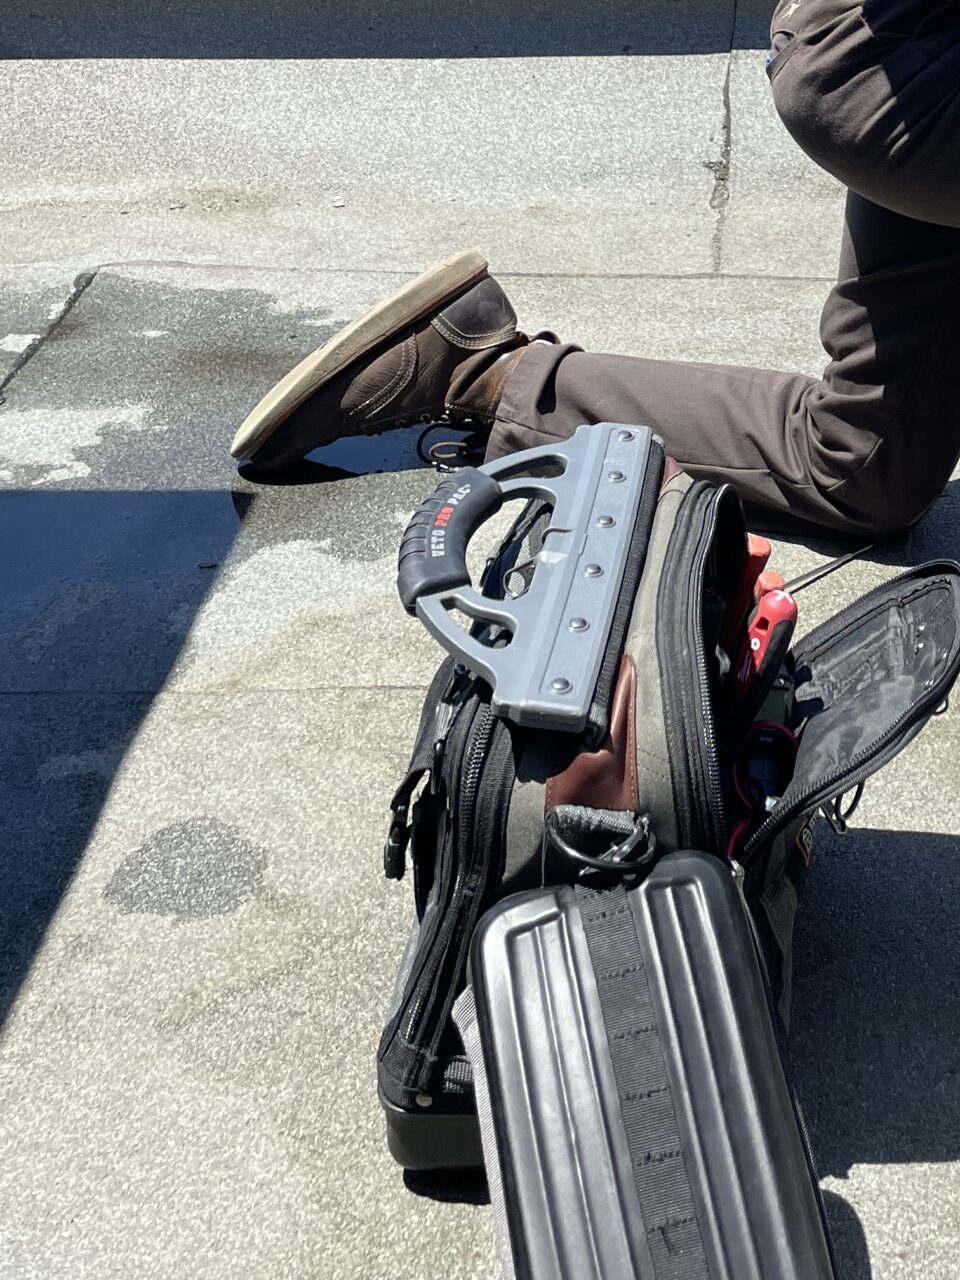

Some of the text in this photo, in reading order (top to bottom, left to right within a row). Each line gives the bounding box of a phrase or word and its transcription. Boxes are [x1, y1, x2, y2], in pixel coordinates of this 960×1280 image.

[431, 484, 471, 558] VETO PRO PAC
